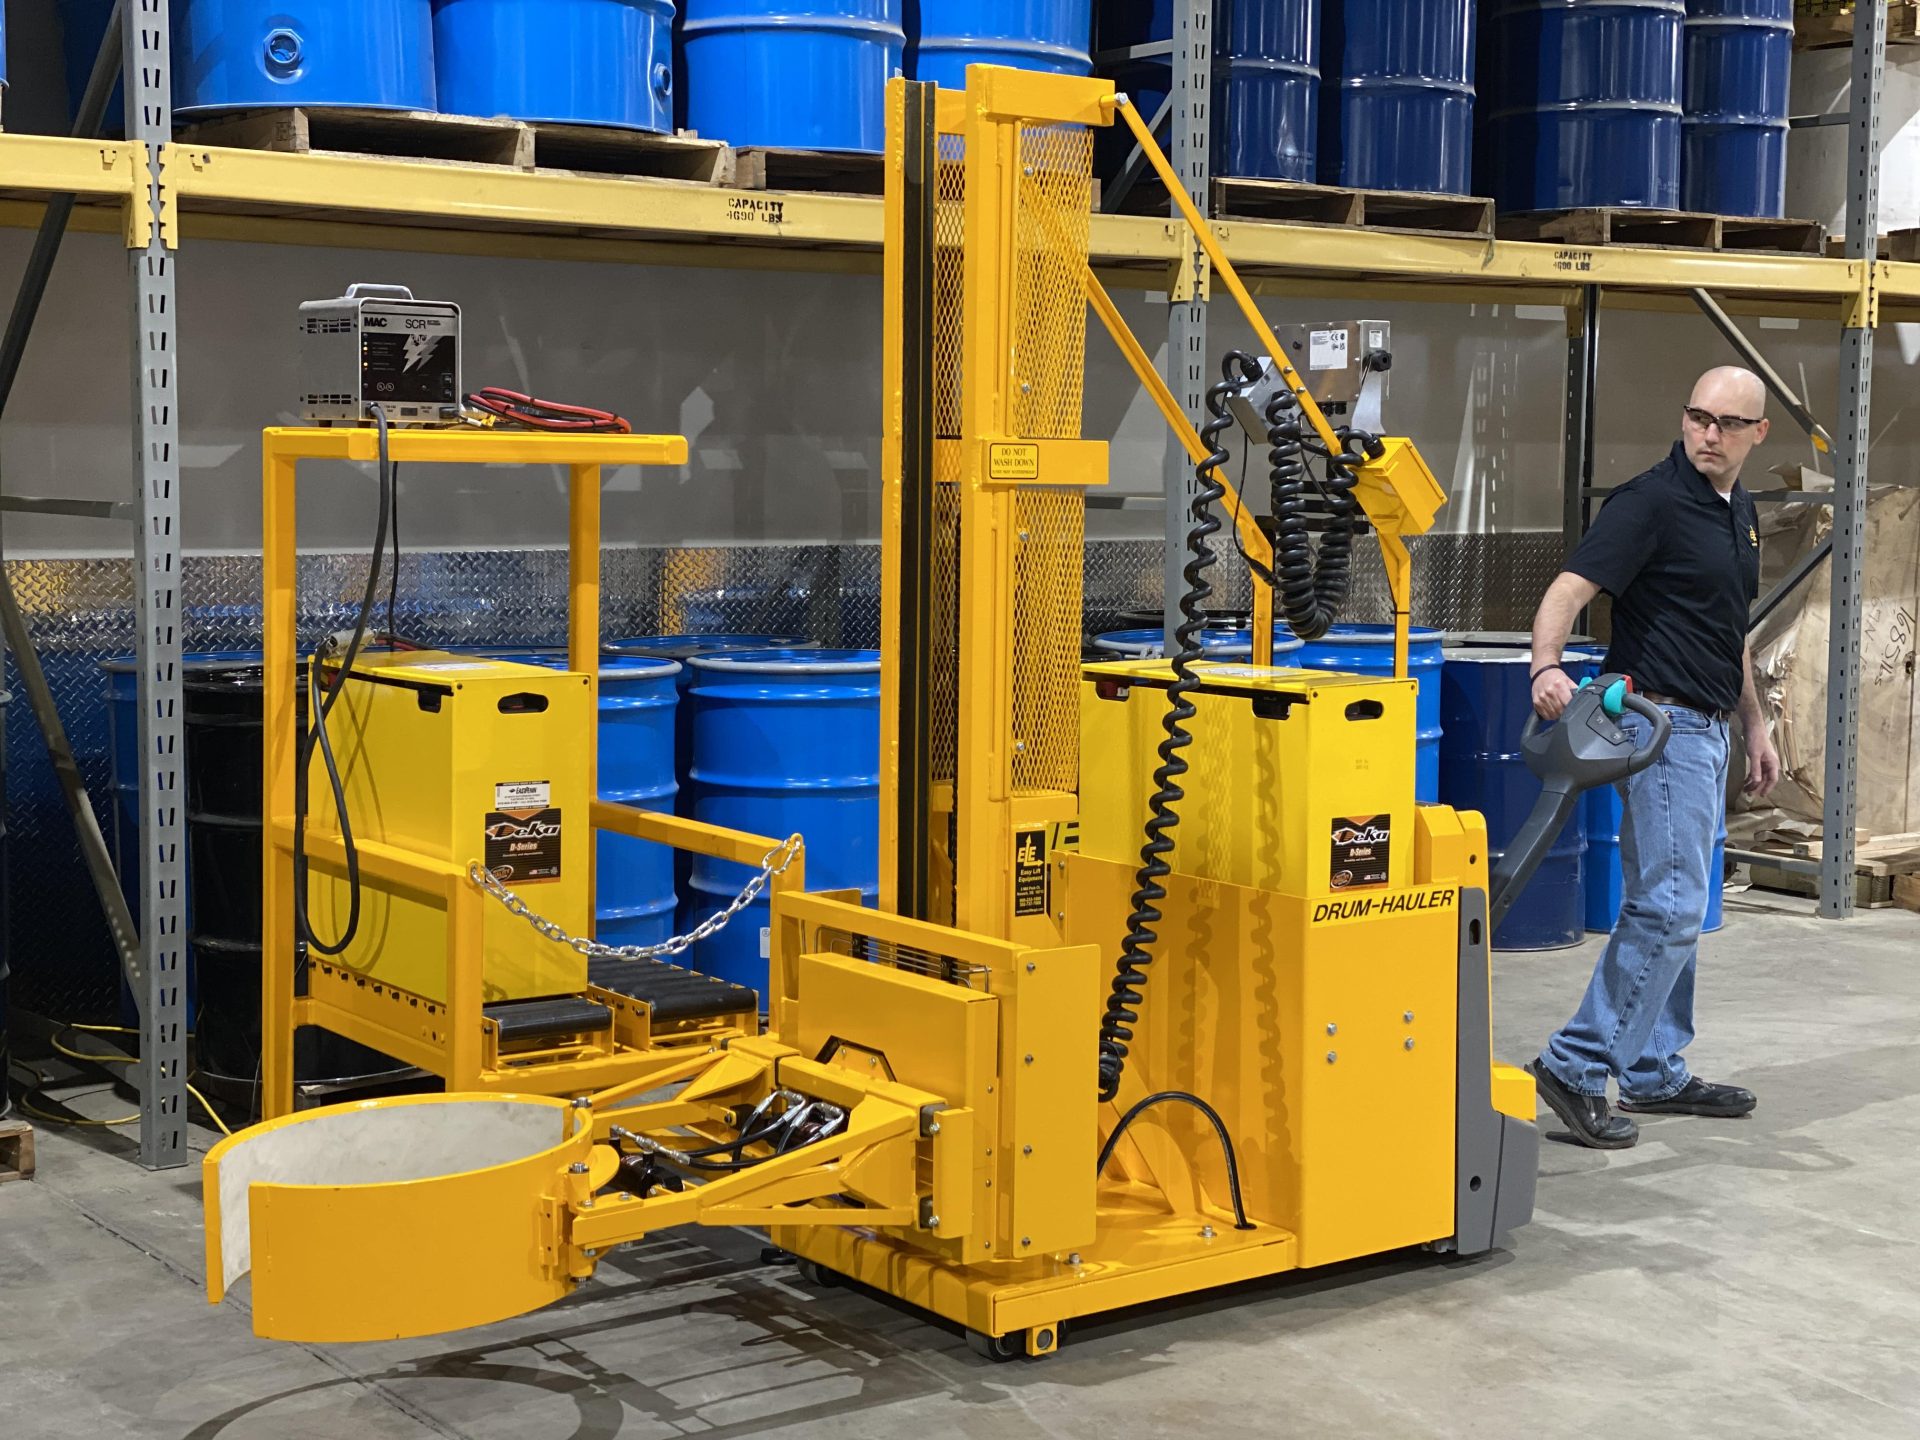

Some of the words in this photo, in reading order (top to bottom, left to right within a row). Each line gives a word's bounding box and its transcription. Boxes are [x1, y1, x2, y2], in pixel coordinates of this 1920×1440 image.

[728, 198, 784, 213] CAPACITY
[761, 212, 783, 223] LBS
[1554, 251, 1593, 261] CAPACITY
[364, 317, 388, 327] MAC
[405, 318, 426, 329] SCR
[1001, 447, 1011, 456] DO
[1013, 447, 1027, 456] NOT
[993, 458, 1013, 467] WASH
[1014, 458, 1035, 467] DOWN
[486, 821, 561, 840] Deka
[1332, 826, 1390, 846] Deka
[509, 842, 538, 852] D-Series
[1349, 847, 1372, 857] D-Series
[1313, 889, 1455, 923] DRUM-HAULER
